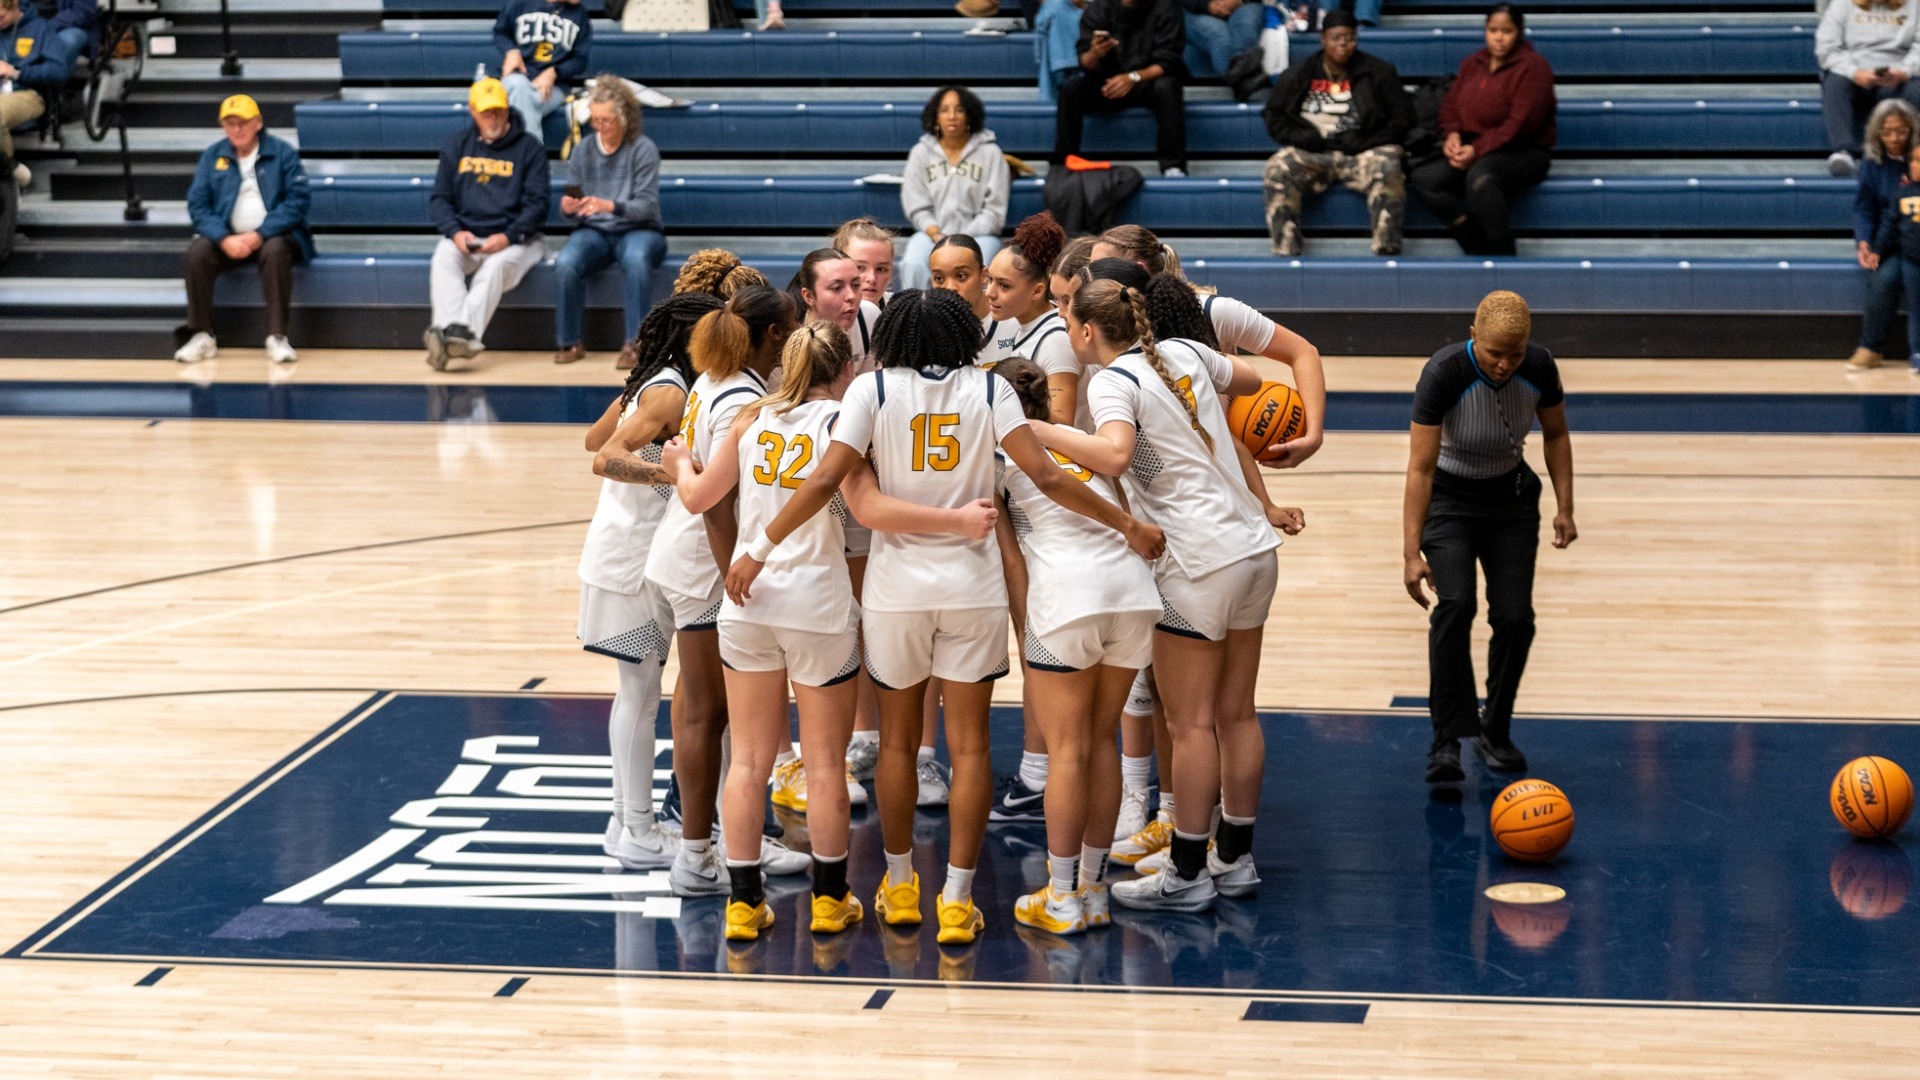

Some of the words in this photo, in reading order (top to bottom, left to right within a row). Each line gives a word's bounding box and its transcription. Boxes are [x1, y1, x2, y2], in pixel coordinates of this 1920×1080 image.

[516, 12, 580, 51] ETSU
[926, 161, 983, 182] ETSU
[1252, 398, 1280, 438] NCAA
[753, 430, 813, 489] 32
[910, 413, 960, 471] 15
[1857, 768, 1878, 805] NCAA
